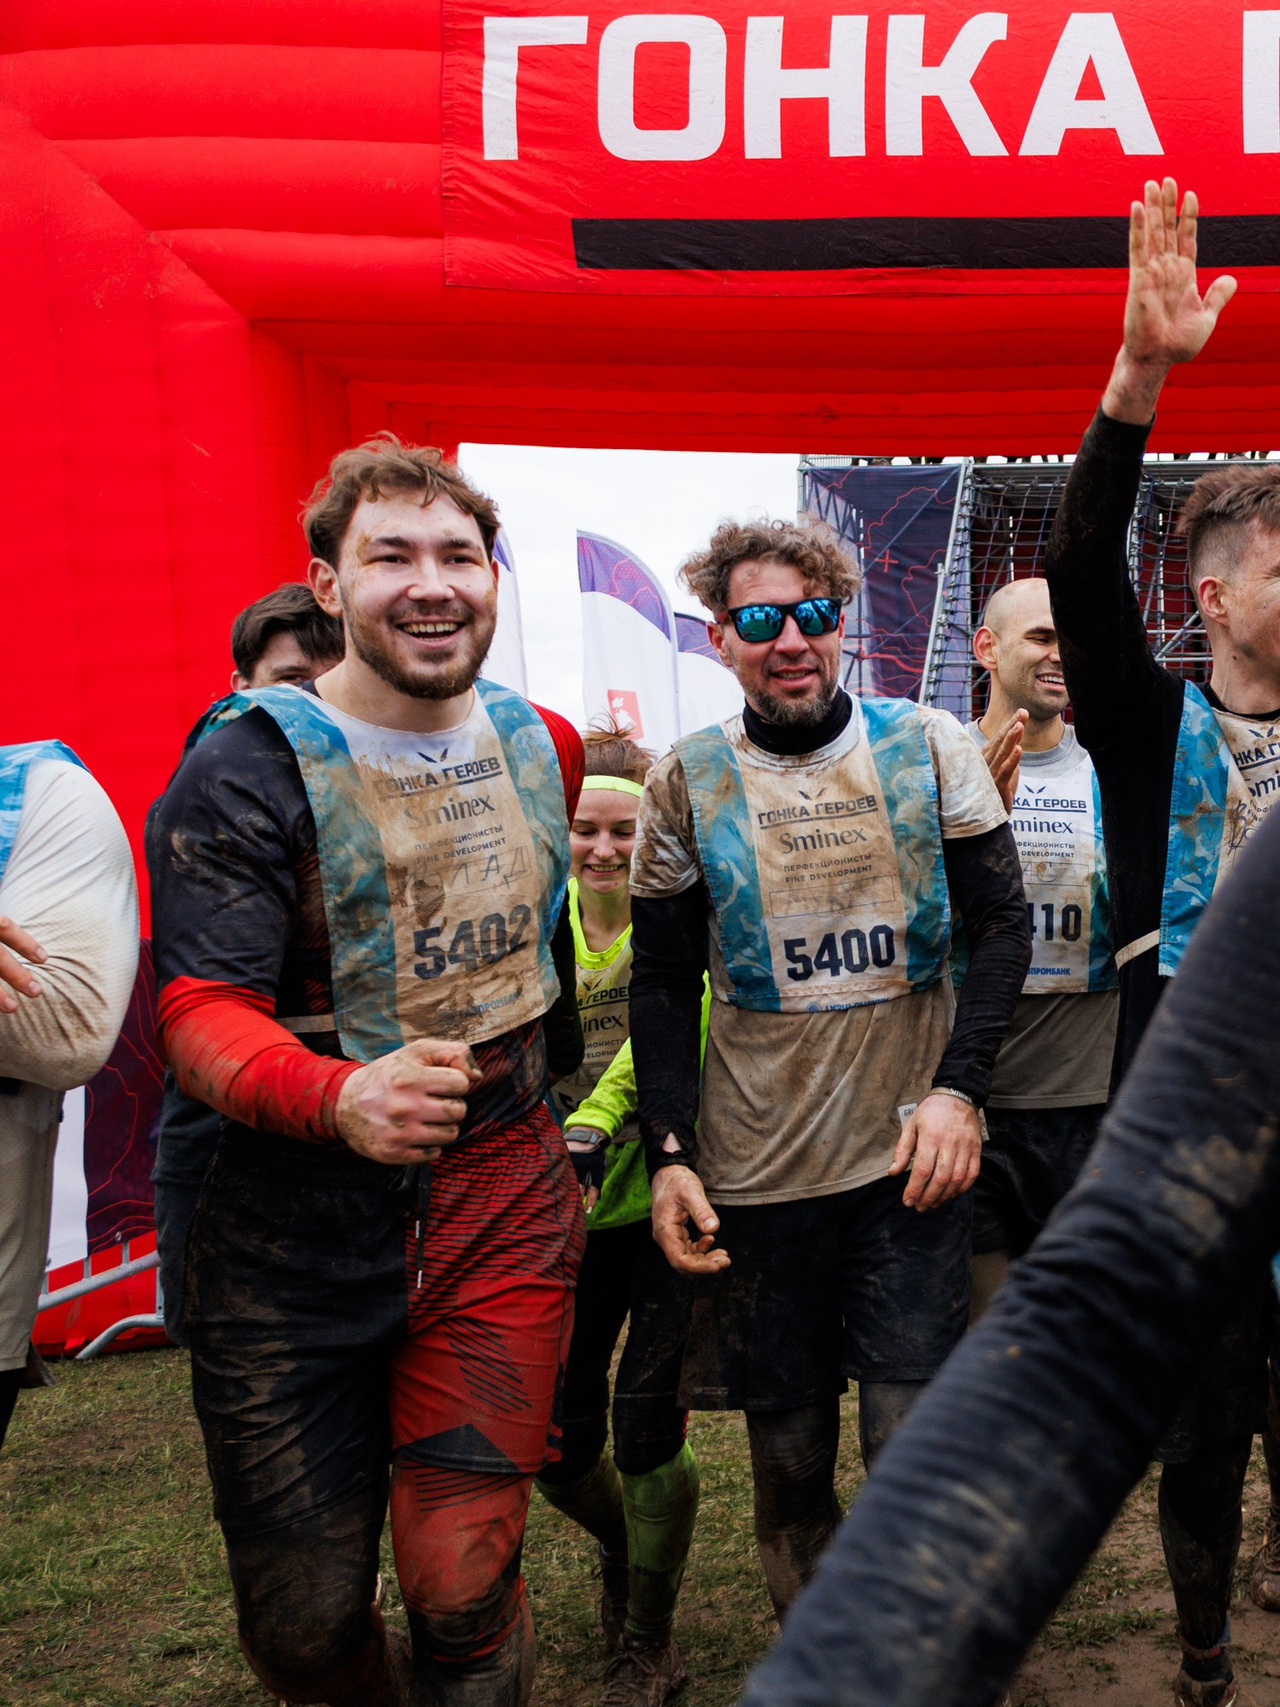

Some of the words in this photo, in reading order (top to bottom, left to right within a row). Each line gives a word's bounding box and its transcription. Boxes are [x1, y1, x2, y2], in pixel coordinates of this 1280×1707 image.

[482, 12, 1164, 161] ГОНКА
[1232, 747, 1266, 766] НКА
[373, 772, 439, 793] ГОНКА
[442, 757, 501, 781] ГЕРОЕВ
[405, 795, 496, 829] Sminex
[757, 805, 810, 825] ГОНКА
[814, 795, 877, 815] ГЕРОЕВ
[1035, 798, 1087, 809] ГЕРОЕВ
[1008, 817, 1074, 834] minex
[414, 825, 504, 850] ПЕРФЕКЦИОНИСТЫ
[778, 827, 867, 854] Sminex
[1017, 841, 1075, 849] ФЕКЦИОНИСТЫ
[416, 853, 440, 864] FINE
[443, 837, 507, 860] DEVELOPMENT
[1021, 850, 1075, 858] DEVELOPMENT
[783, 853, 872, 872] ПЕРФЕКЦИОНИСТЫ
[785, 874, 806, 883] FINE
[809, 864, 873, 881] DEVELOPMENT
[413, 904, 531, 980] 5402
[784, 924, 896, 982] 5400
[1026, 967, 1070, 976] ЗПРОМБАНК
[586, 987, 628, 1004] ГЕРОЕ
[583, 1014, 624, 1033] inex
